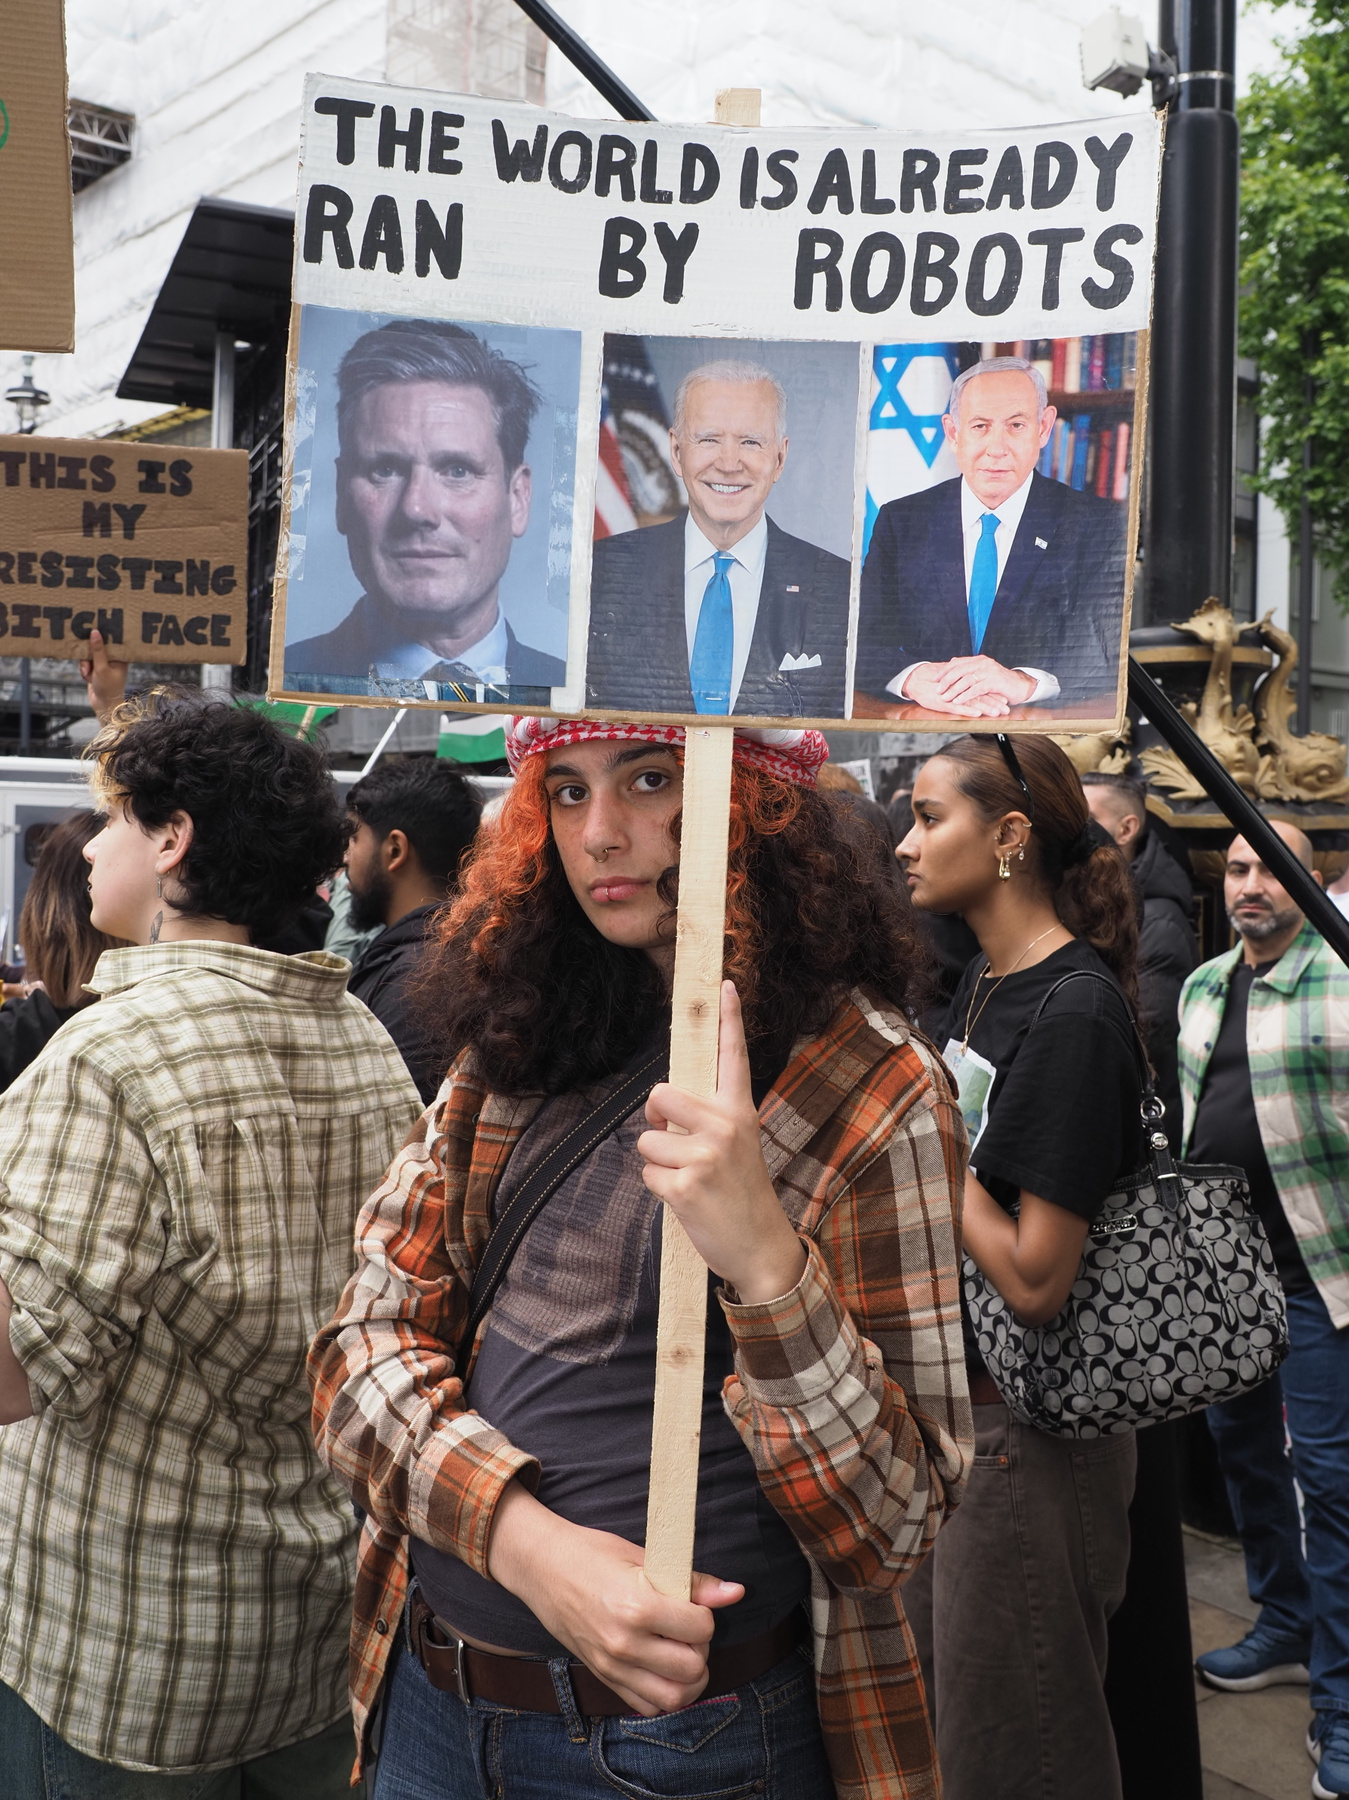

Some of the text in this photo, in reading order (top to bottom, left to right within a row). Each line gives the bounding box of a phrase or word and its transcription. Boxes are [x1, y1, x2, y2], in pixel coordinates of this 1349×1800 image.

[314, 96, 1134, 216] THE WORLD IS ALREADY
[302, 184, 1144, 317] RAN BY ROBOTS
[0, 450, 194, 498] THIS IS
[81, 500, 148, 541] MY
[0, 550, 238, 597] RESISTING
[141, 611, 232, 647] FACE
